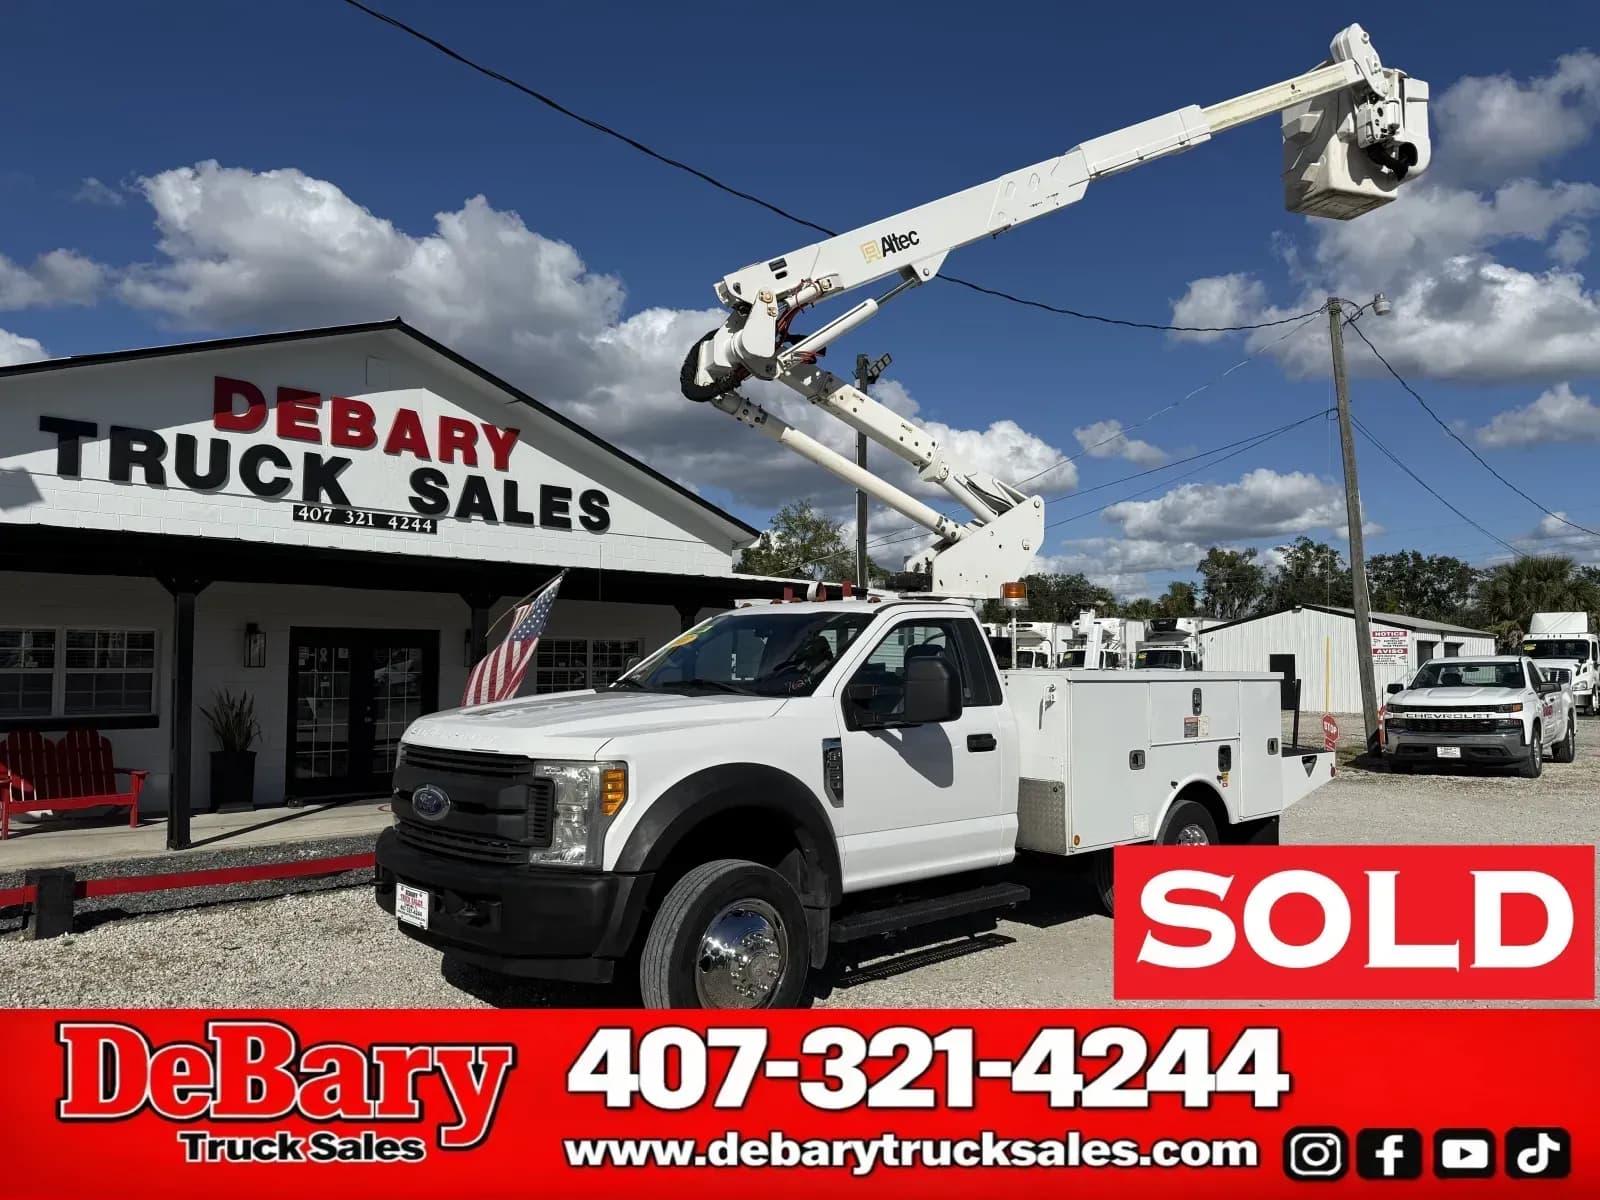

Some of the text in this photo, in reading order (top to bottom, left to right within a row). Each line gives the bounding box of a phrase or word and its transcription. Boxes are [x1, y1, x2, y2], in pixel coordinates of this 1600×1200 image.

[881, 231, 919, 257] Altec
[213, 375, 520, 471] DEBARY
[40, 415, 611, 533] TRUCK SALES
[298, 506, 432, 533] 407 321 4244
